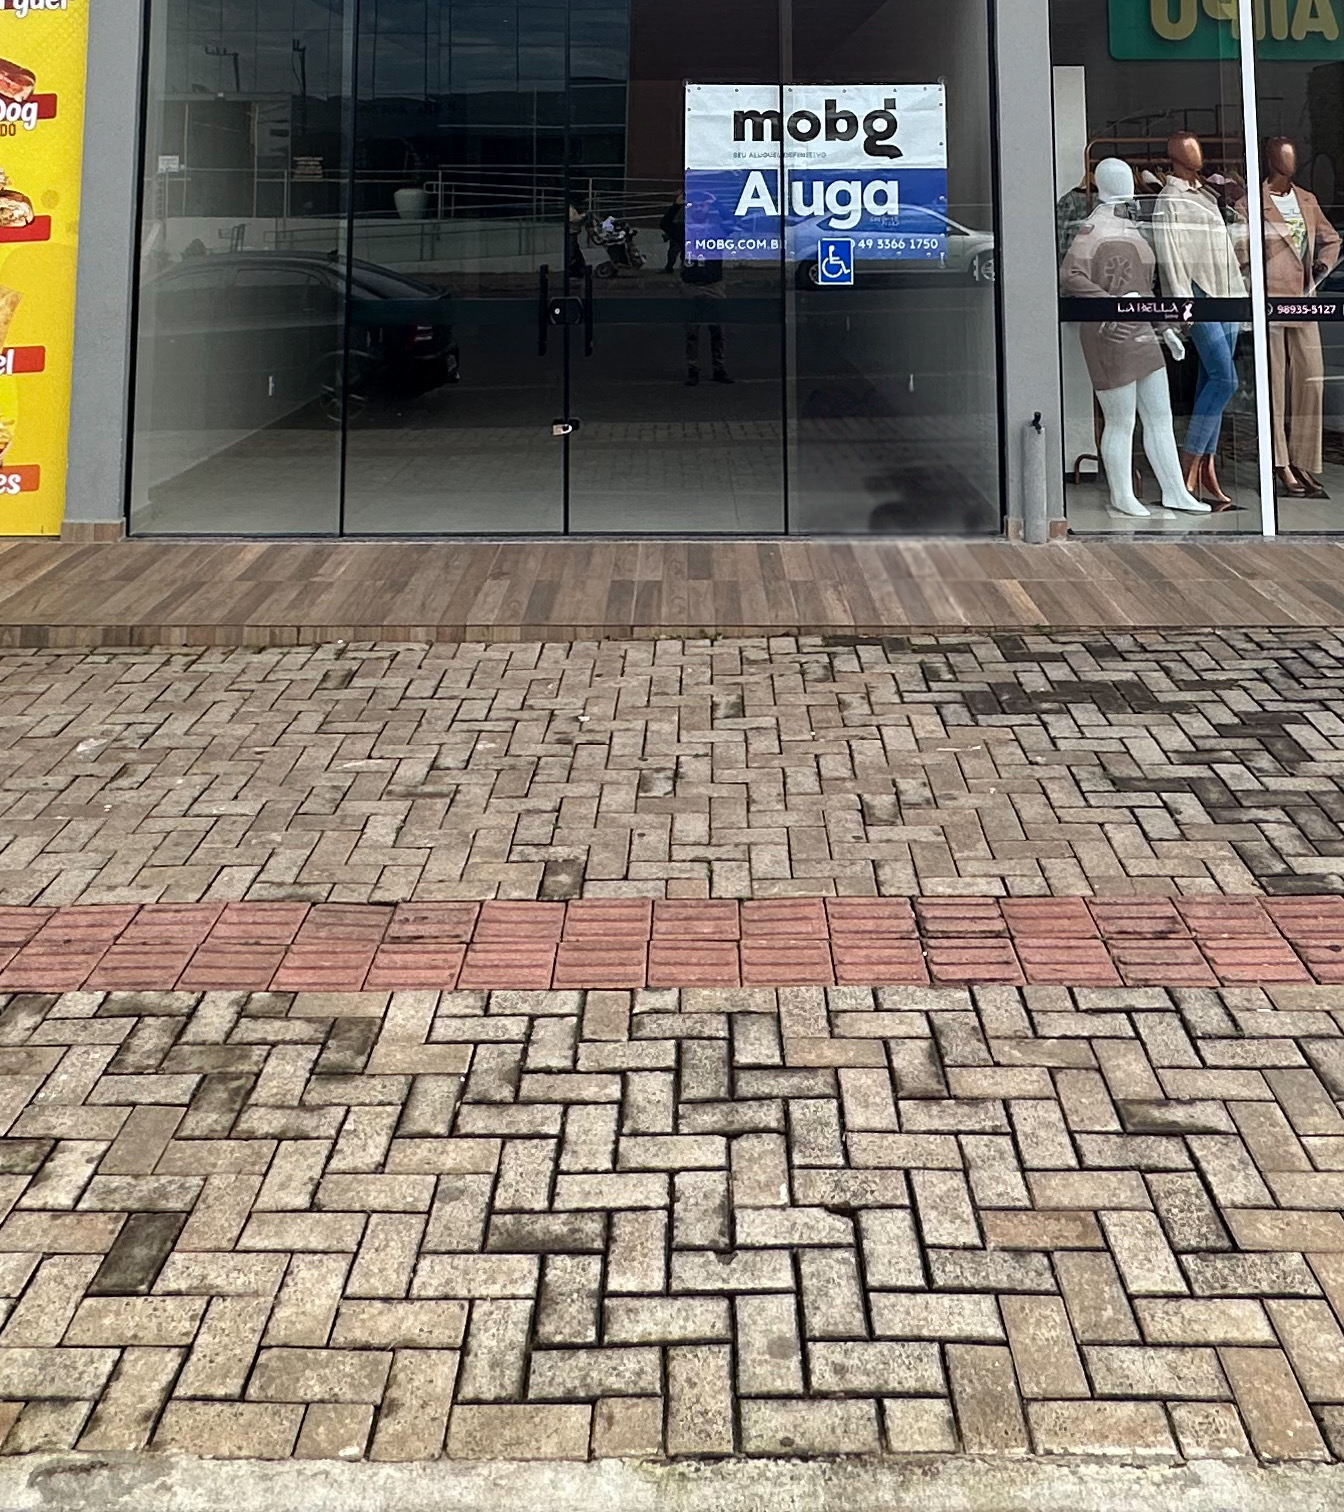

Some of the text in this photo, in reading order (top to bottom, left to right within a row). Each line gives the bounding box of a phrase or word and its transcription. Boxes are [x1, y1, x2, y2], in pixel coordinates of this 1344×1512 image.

[733, 98, 904, 159] mobg
[734, 170, 900, 230] Aluga
[858, 238, 874, 249] 49
[877, 238, 906, 249] 3366
[909, 238, 939, 250] 1750
